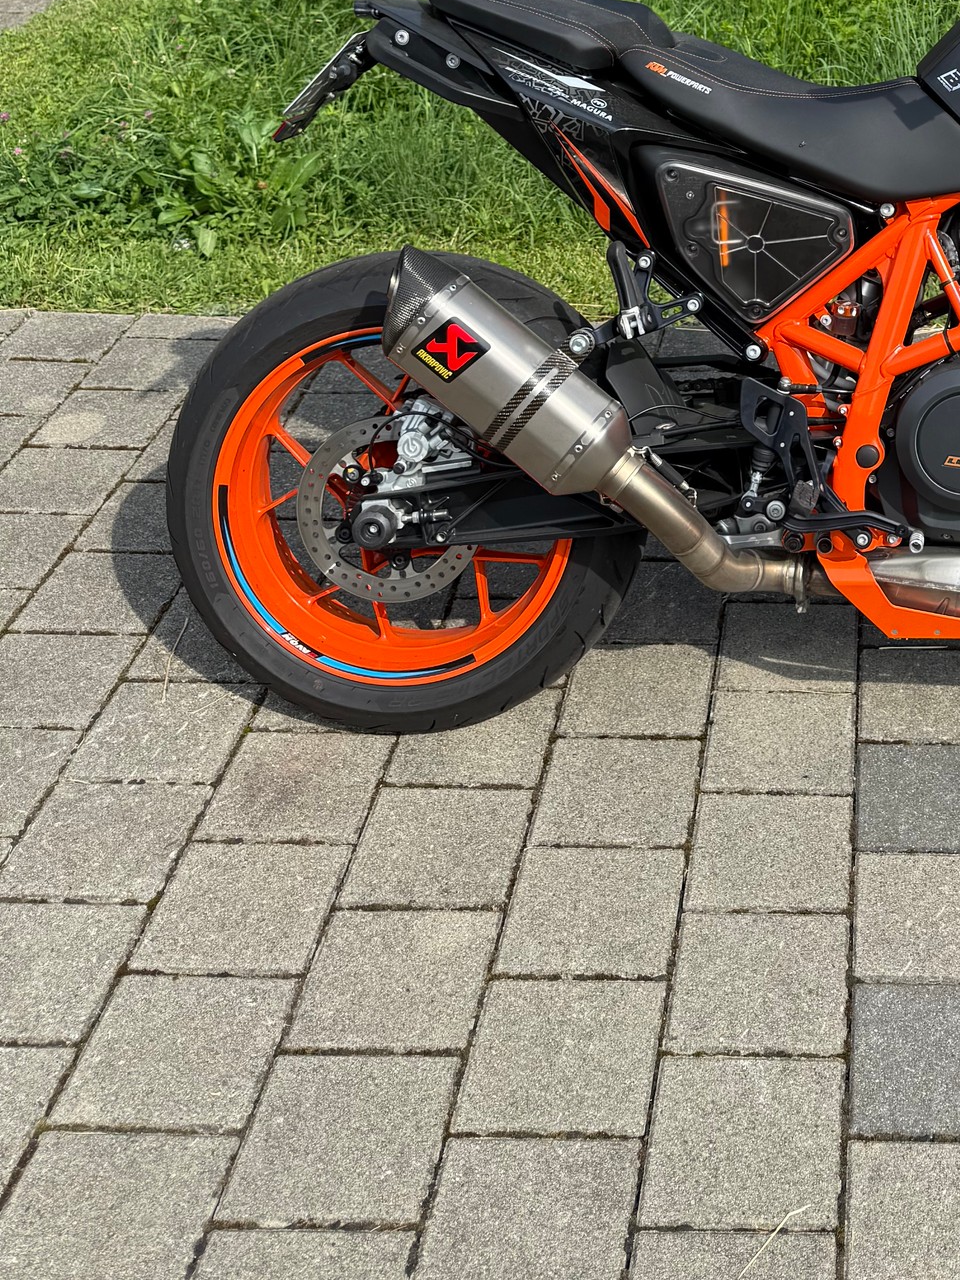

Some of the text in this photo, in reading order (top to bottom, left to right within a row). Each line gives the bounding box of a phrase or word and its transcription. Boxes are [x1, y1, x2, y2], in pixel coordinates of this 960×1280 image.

[666, 70, 712, 95] POWERPARTS
[570, 99, 613, 122] MAGURA
[281, 633, 311, 654] AVON
